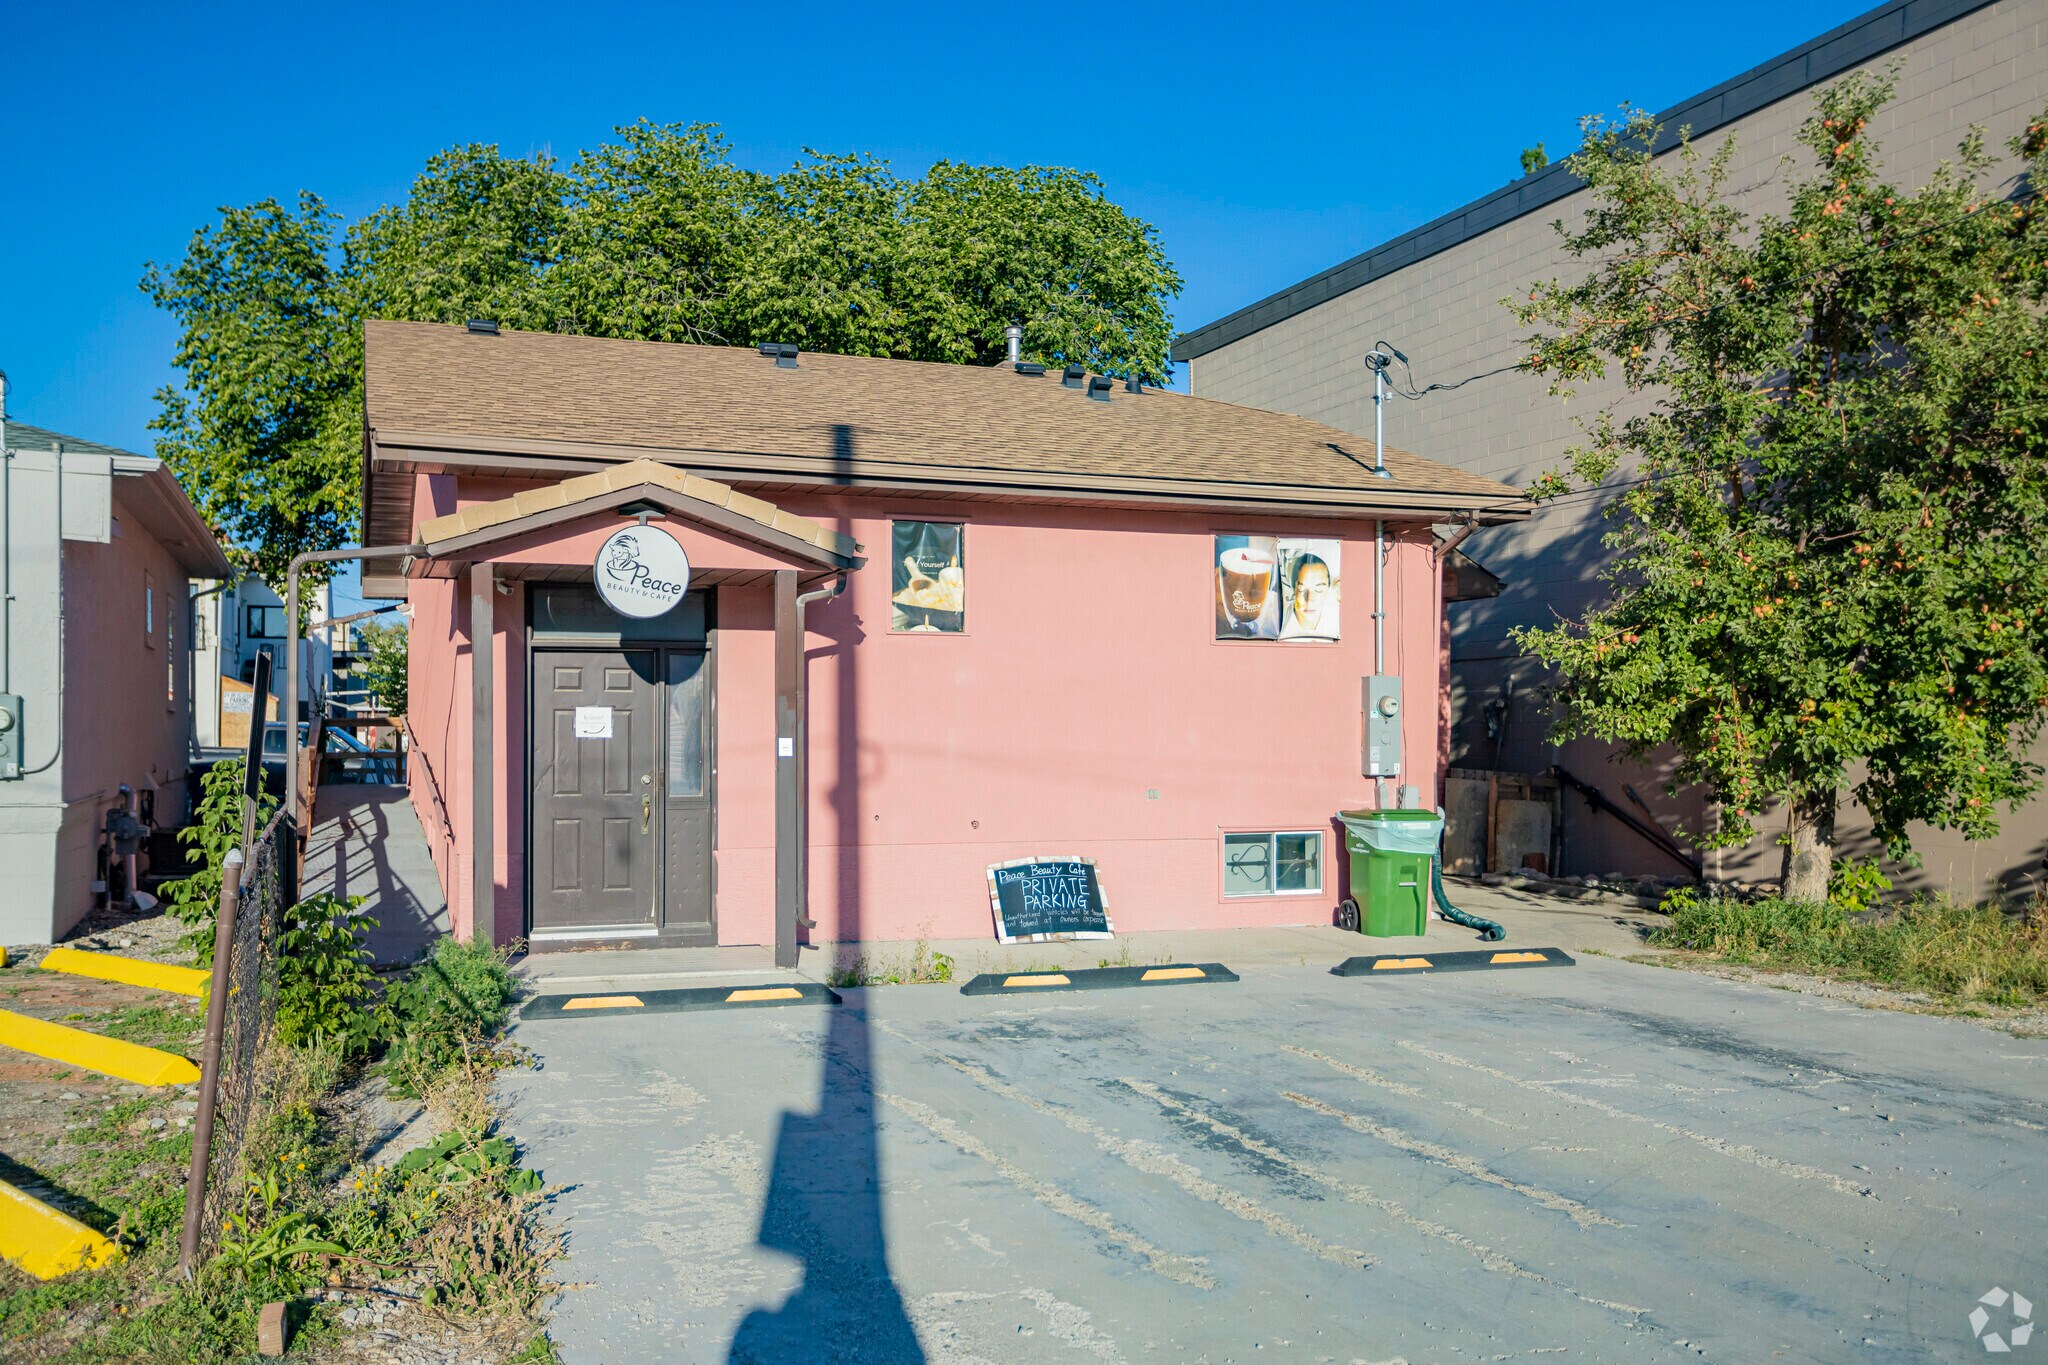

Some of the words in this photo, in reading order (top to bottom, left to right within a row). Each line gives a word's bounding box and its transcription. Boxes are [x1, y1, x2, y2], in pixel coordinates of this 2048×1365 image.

[630, 564, 682, 595] Peace
[606, 582, 640, 596] BEAUTY
[650, 592, 672, 603] CAFE
[999, 871, 1025, 883] Peace
[1030, 864, 1062, 875] Beauty
[1021, 878, 1090, 896] PRIVATE
[1024, 893, 1087, 910] PARKING
[1019, 918, 1039, 928] towed
